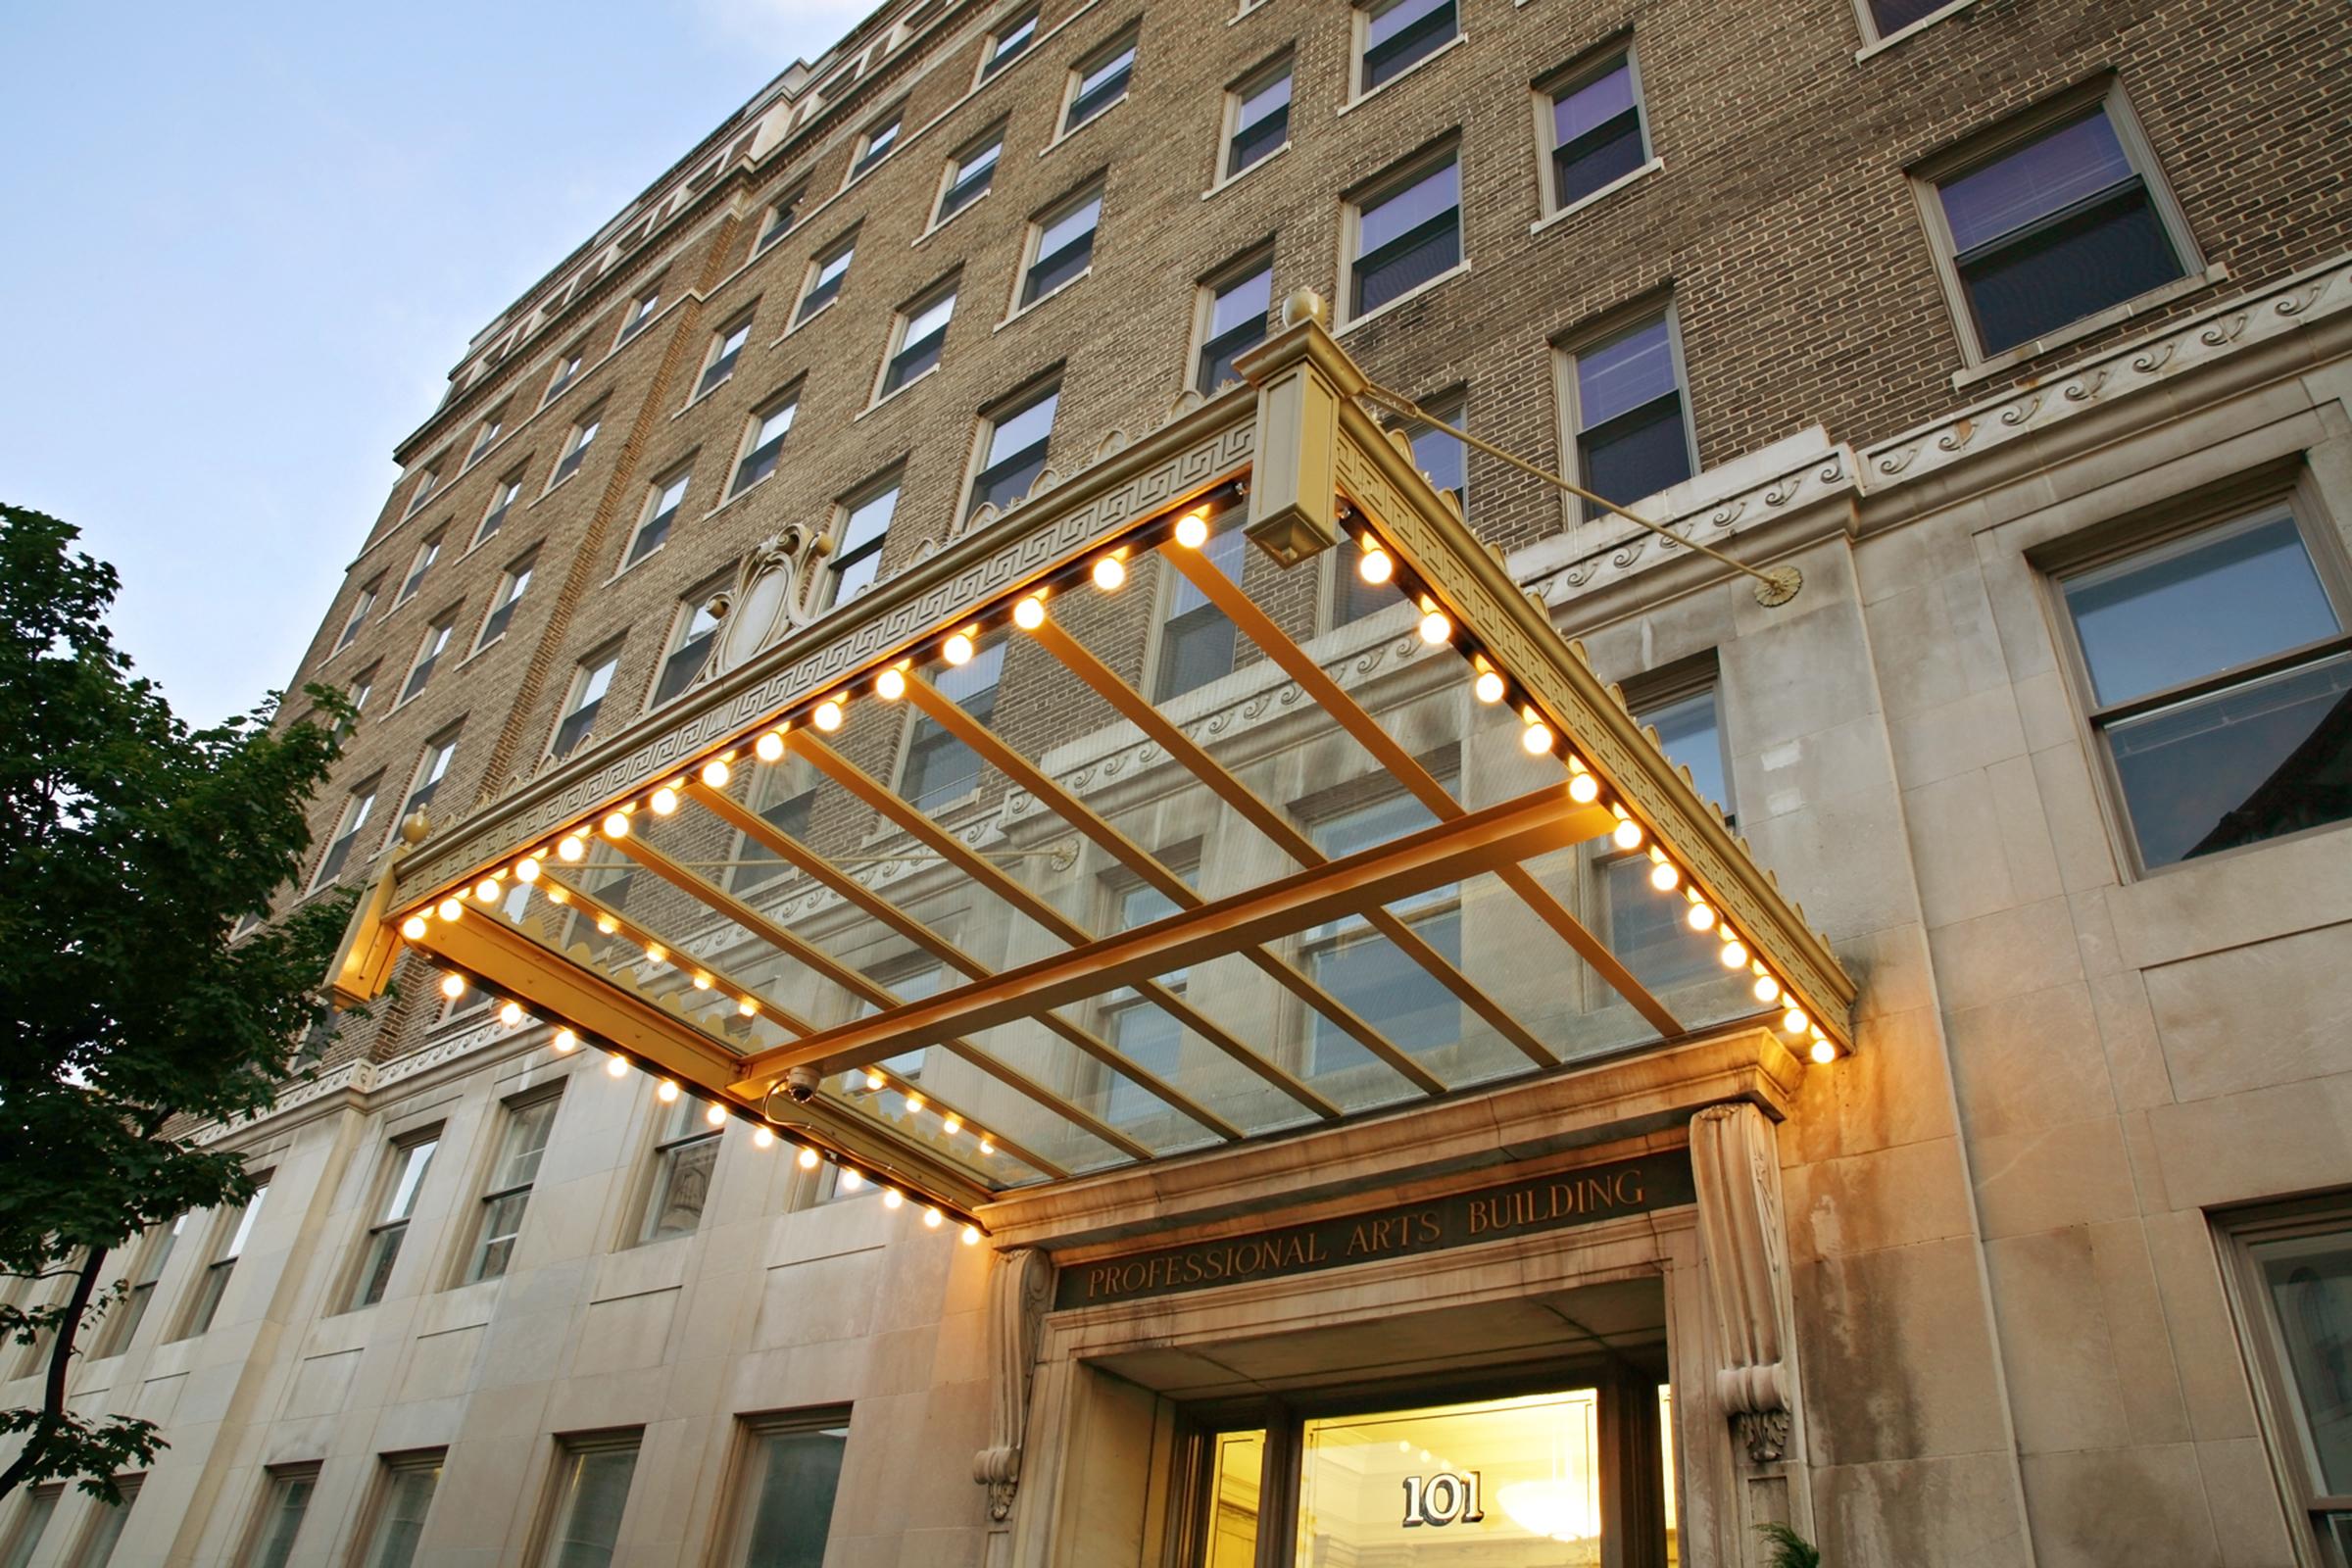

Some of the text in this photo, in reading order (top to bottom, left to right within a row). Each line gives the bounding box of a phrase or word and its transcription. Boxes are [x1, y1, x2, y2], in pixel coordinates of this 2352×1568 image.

[1089, 1169, 1644, 1298] PROFESSIONAL ARTS BUILDING
[1402, 1470, 1485, 1528] 101
